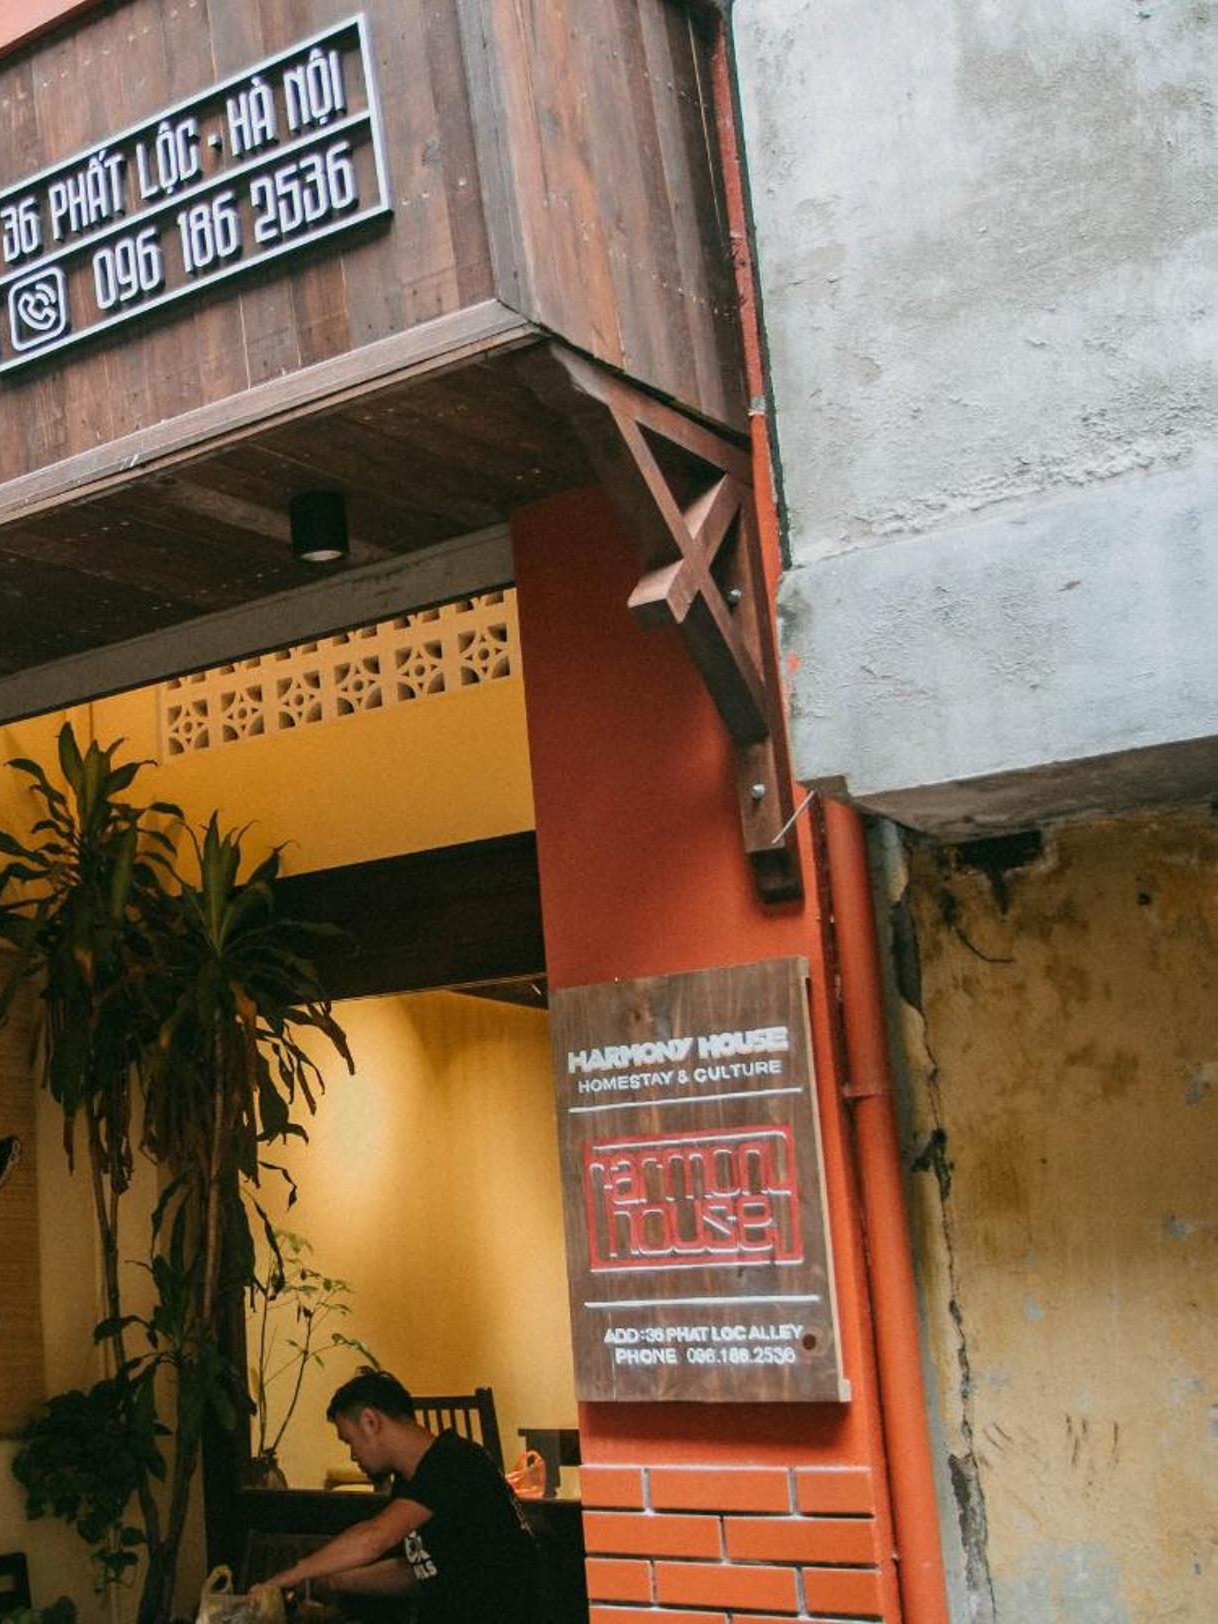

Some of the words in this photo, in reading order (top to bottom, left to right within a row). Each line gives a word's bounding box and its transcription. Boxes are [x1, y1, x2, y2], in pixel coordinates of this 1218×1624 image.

[0, 197, 44, 265] 36
[48, 149, 126, 241] PHẤT
[135, 116, 201, 199] LỘC
[226, 76, 279, 157] HÀ
[92, 225, 165, 311] 096
[177, 190, 242, 274] 186
[250, 139, 357, 244] 2536
[568, 1037, 693, 1074] HARMONY
[697, 1026, 789, 1060] HOUSE
[578, 1070, 673, 1094] HOMESTAY
[694, 1060, 782, 1084] CULTURE
[607, 1192, 776, 1257] house
[615, 1348, 678, 1365] PHONE
[666, 1326, 709, 1342] PHAT
[711, 1325, 747, 1341] LOC
[748, 1324, 805, 1341] ALLEY
